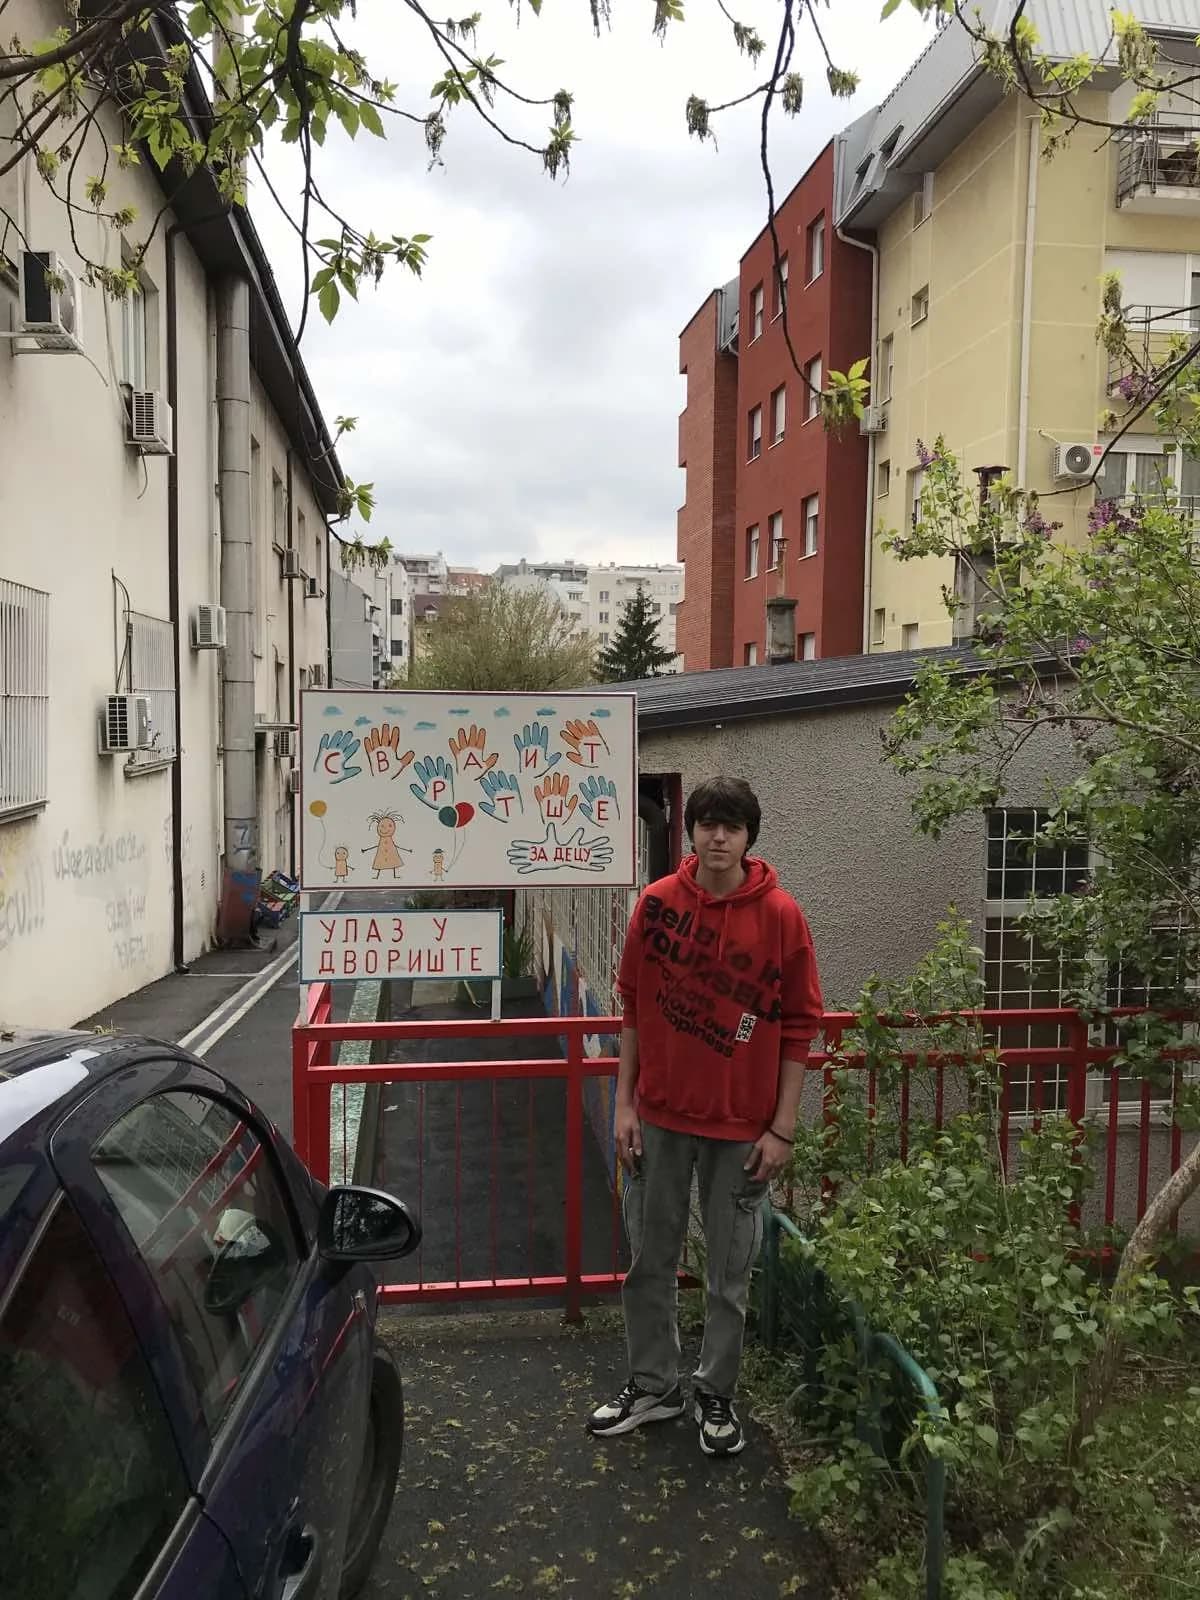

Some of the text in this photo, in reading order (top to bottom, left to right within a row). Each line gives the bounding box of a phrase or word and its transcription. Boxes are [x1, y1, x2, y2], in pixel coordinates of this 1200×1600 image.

[530, 846, 592, 862] ЗА ДЕЦУ
[319, 917, 447, 943] УЛАЗ У
[318, 947, 483, 975] ДВОРИШТЕ
